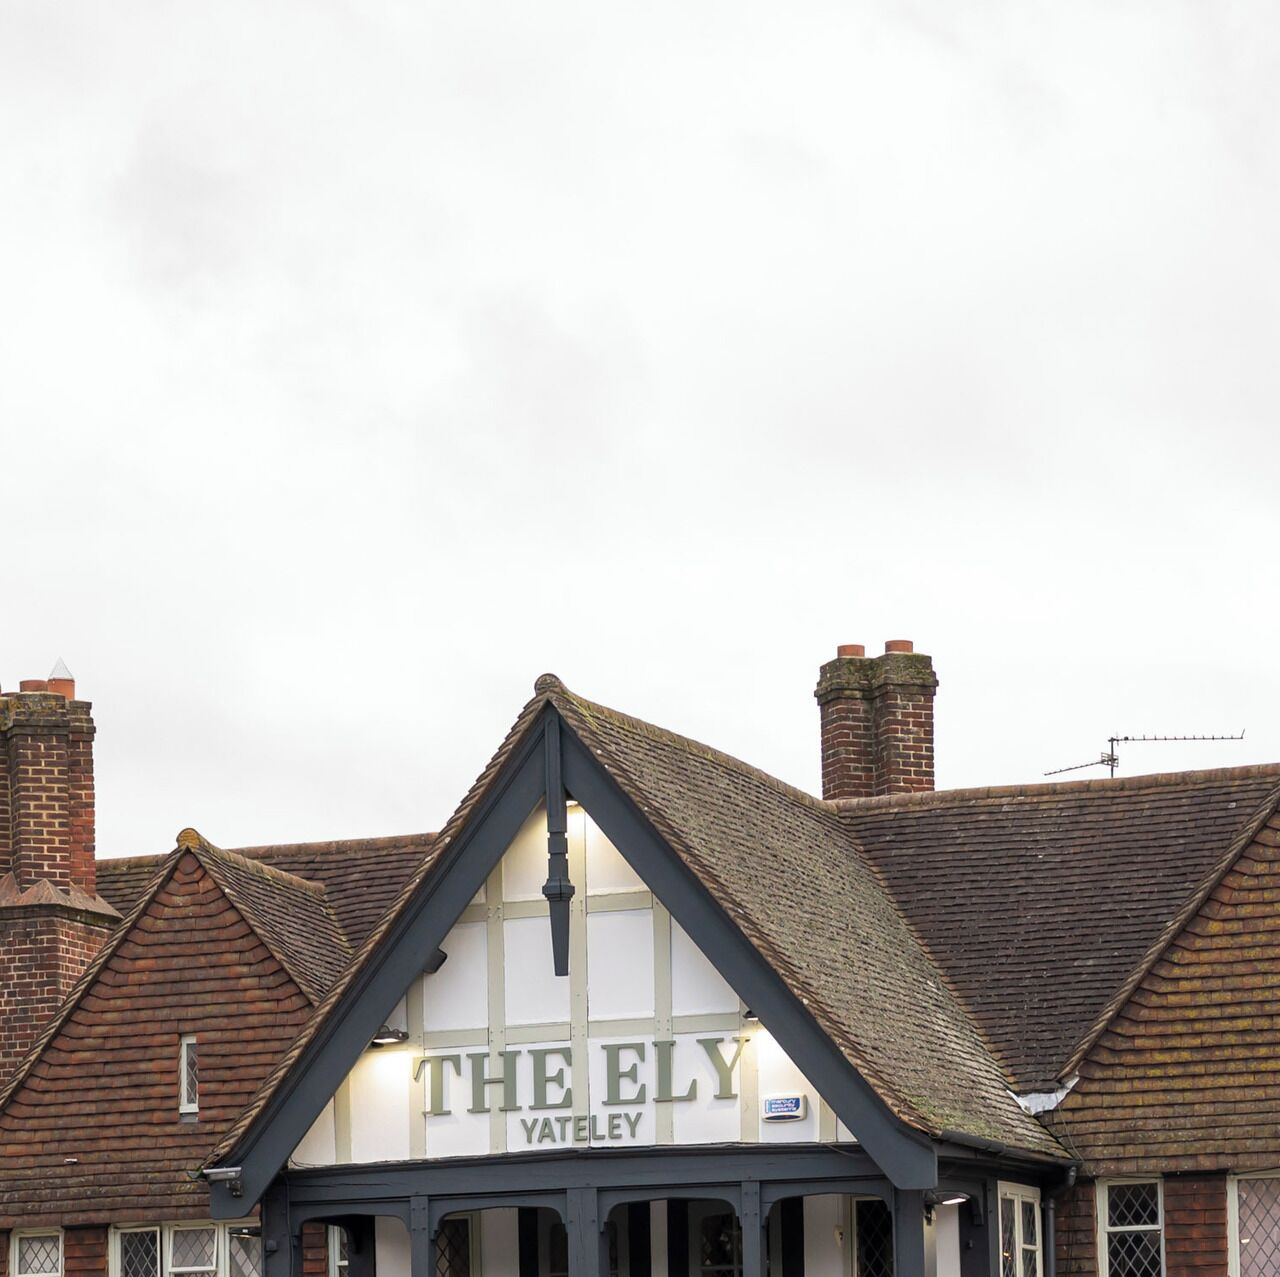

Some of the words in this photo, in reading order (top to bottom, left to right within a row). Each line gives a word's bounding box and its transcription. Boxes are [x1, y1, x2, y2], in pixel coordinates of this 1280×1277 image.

[413, 1047, 573, 1116] THE
[601, 1036, 751, 1106] ELY
[521, 1111, 643, 1144] YATELEY
